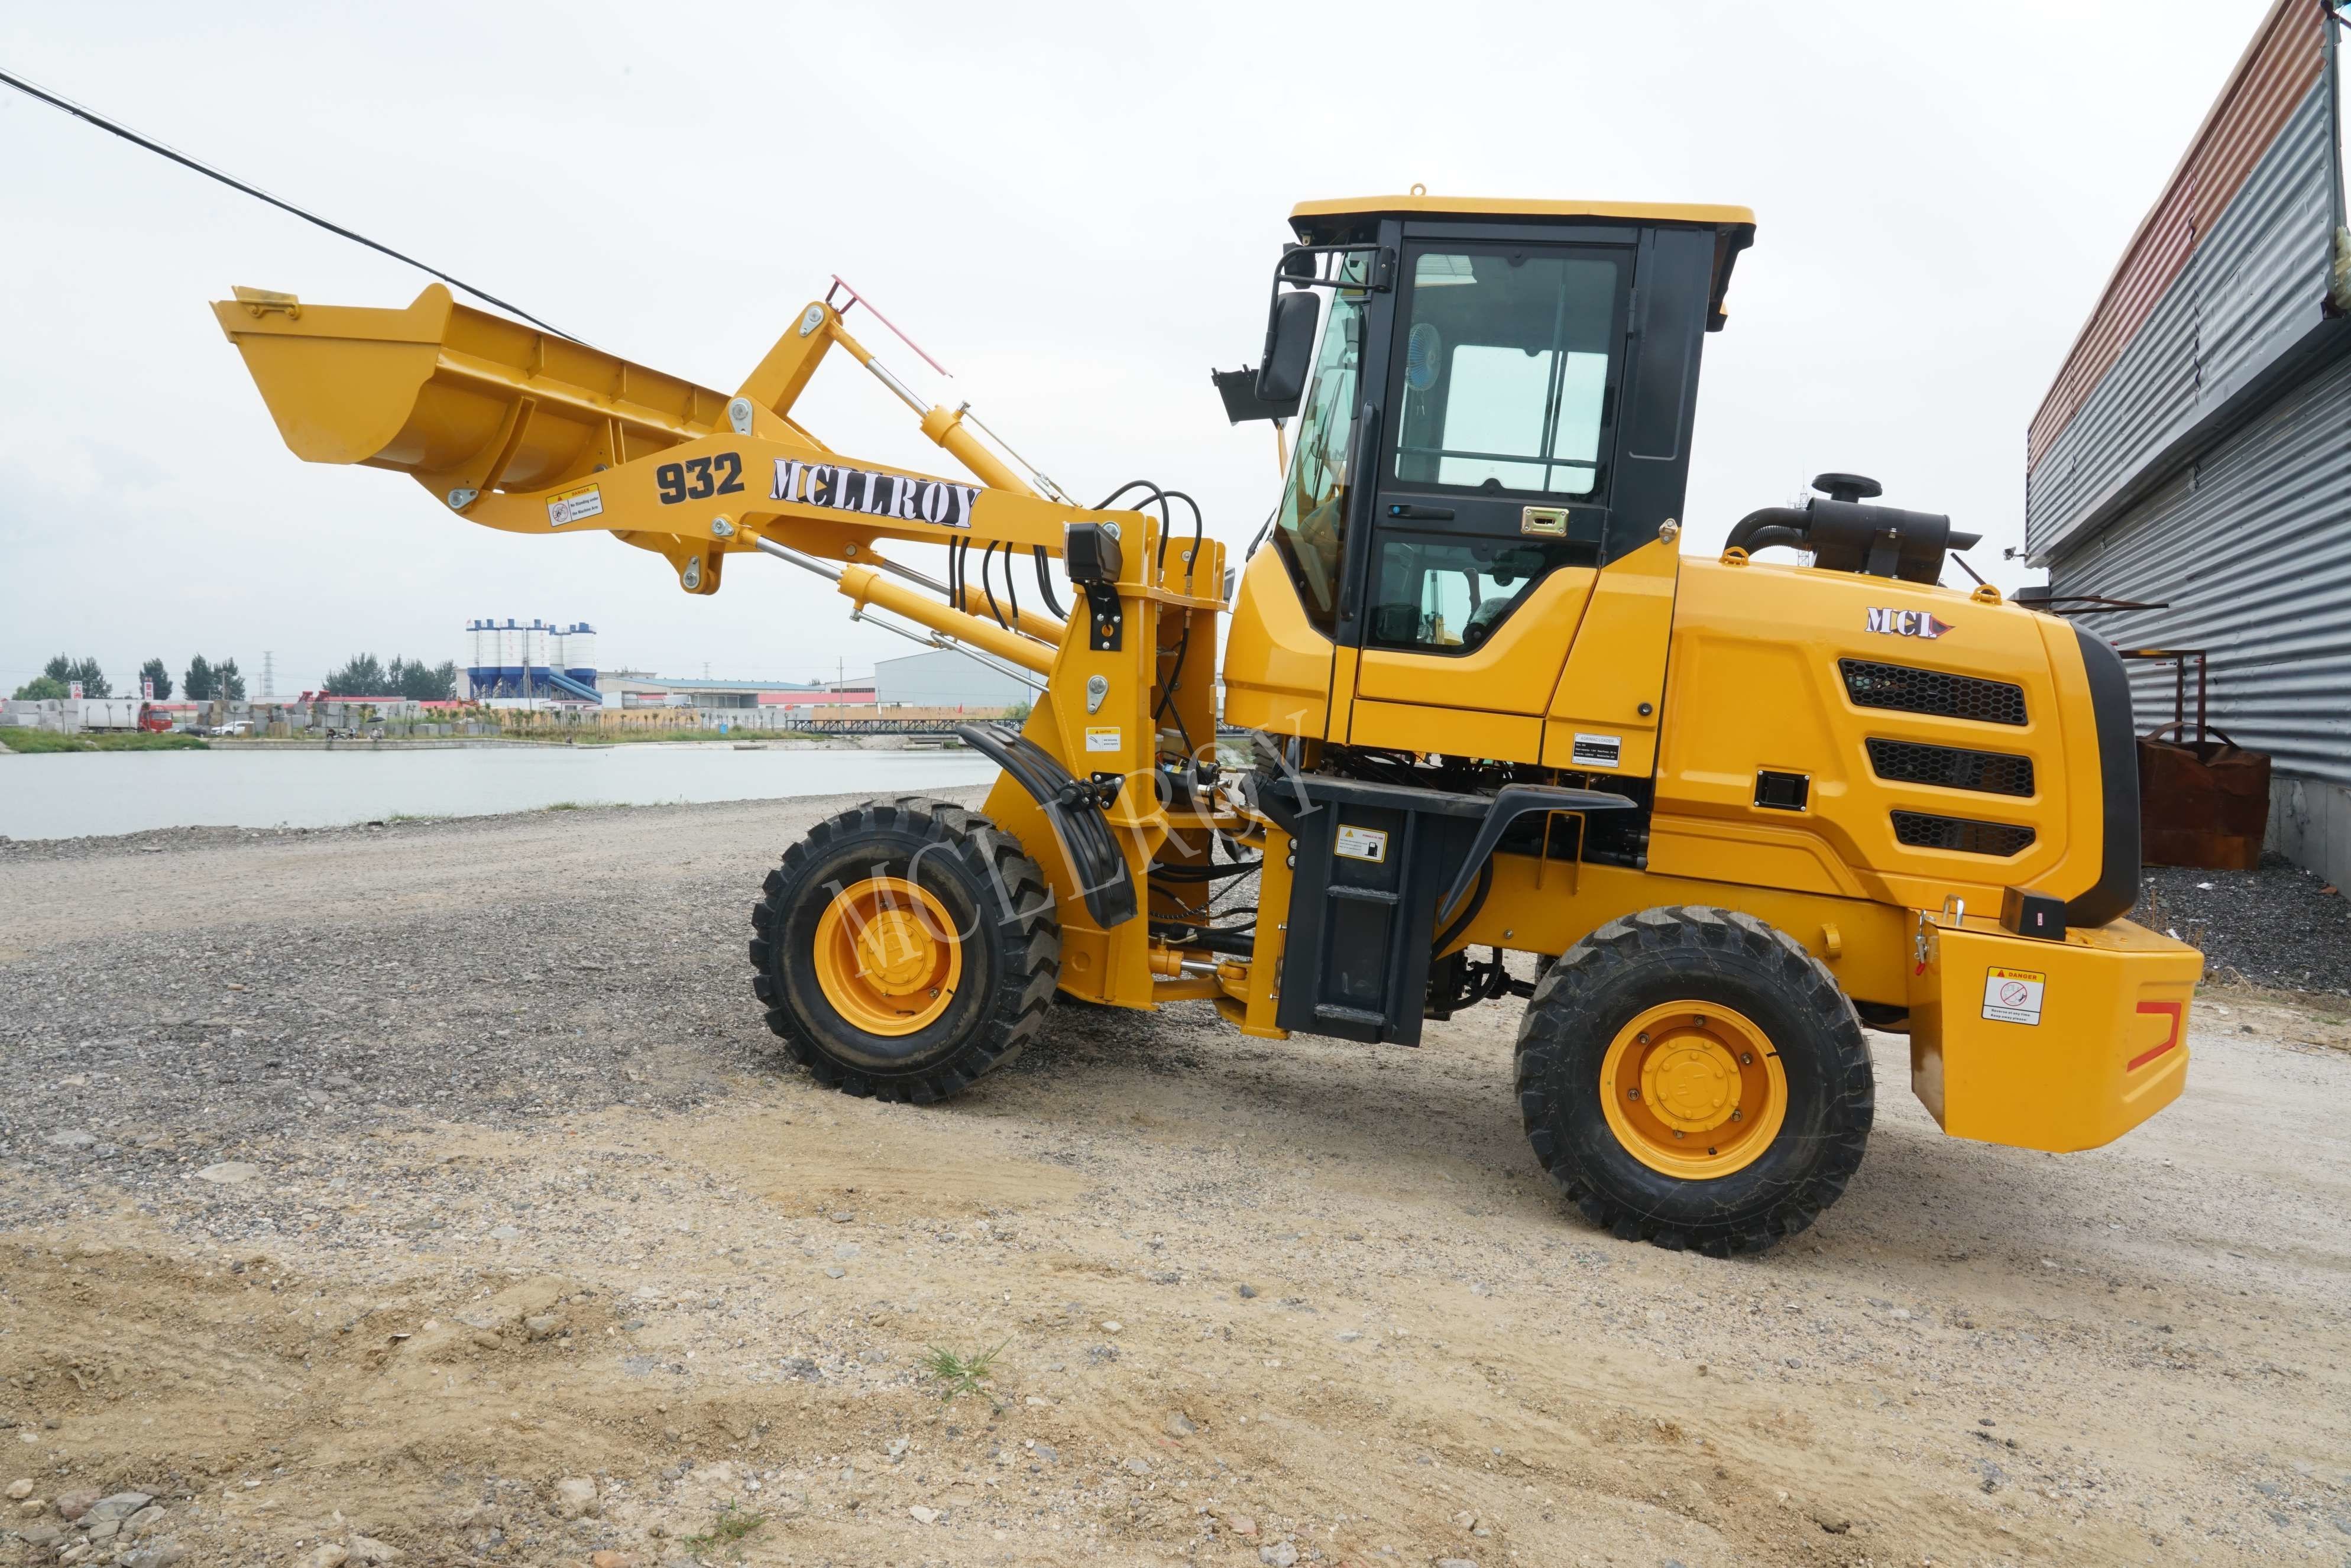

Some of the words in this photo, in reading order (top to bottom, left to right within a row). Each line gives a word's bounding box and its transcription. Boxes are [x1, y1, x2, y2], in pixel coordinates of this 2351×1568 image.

[572, 487, 590, 496] DANGER
[656, 452, 745, 505] 932
[769, 458, 983, 529] MCLLROY
[1864, 607, 1938, 639] MCL
[2009, 971, 2037, 980] DANGER
